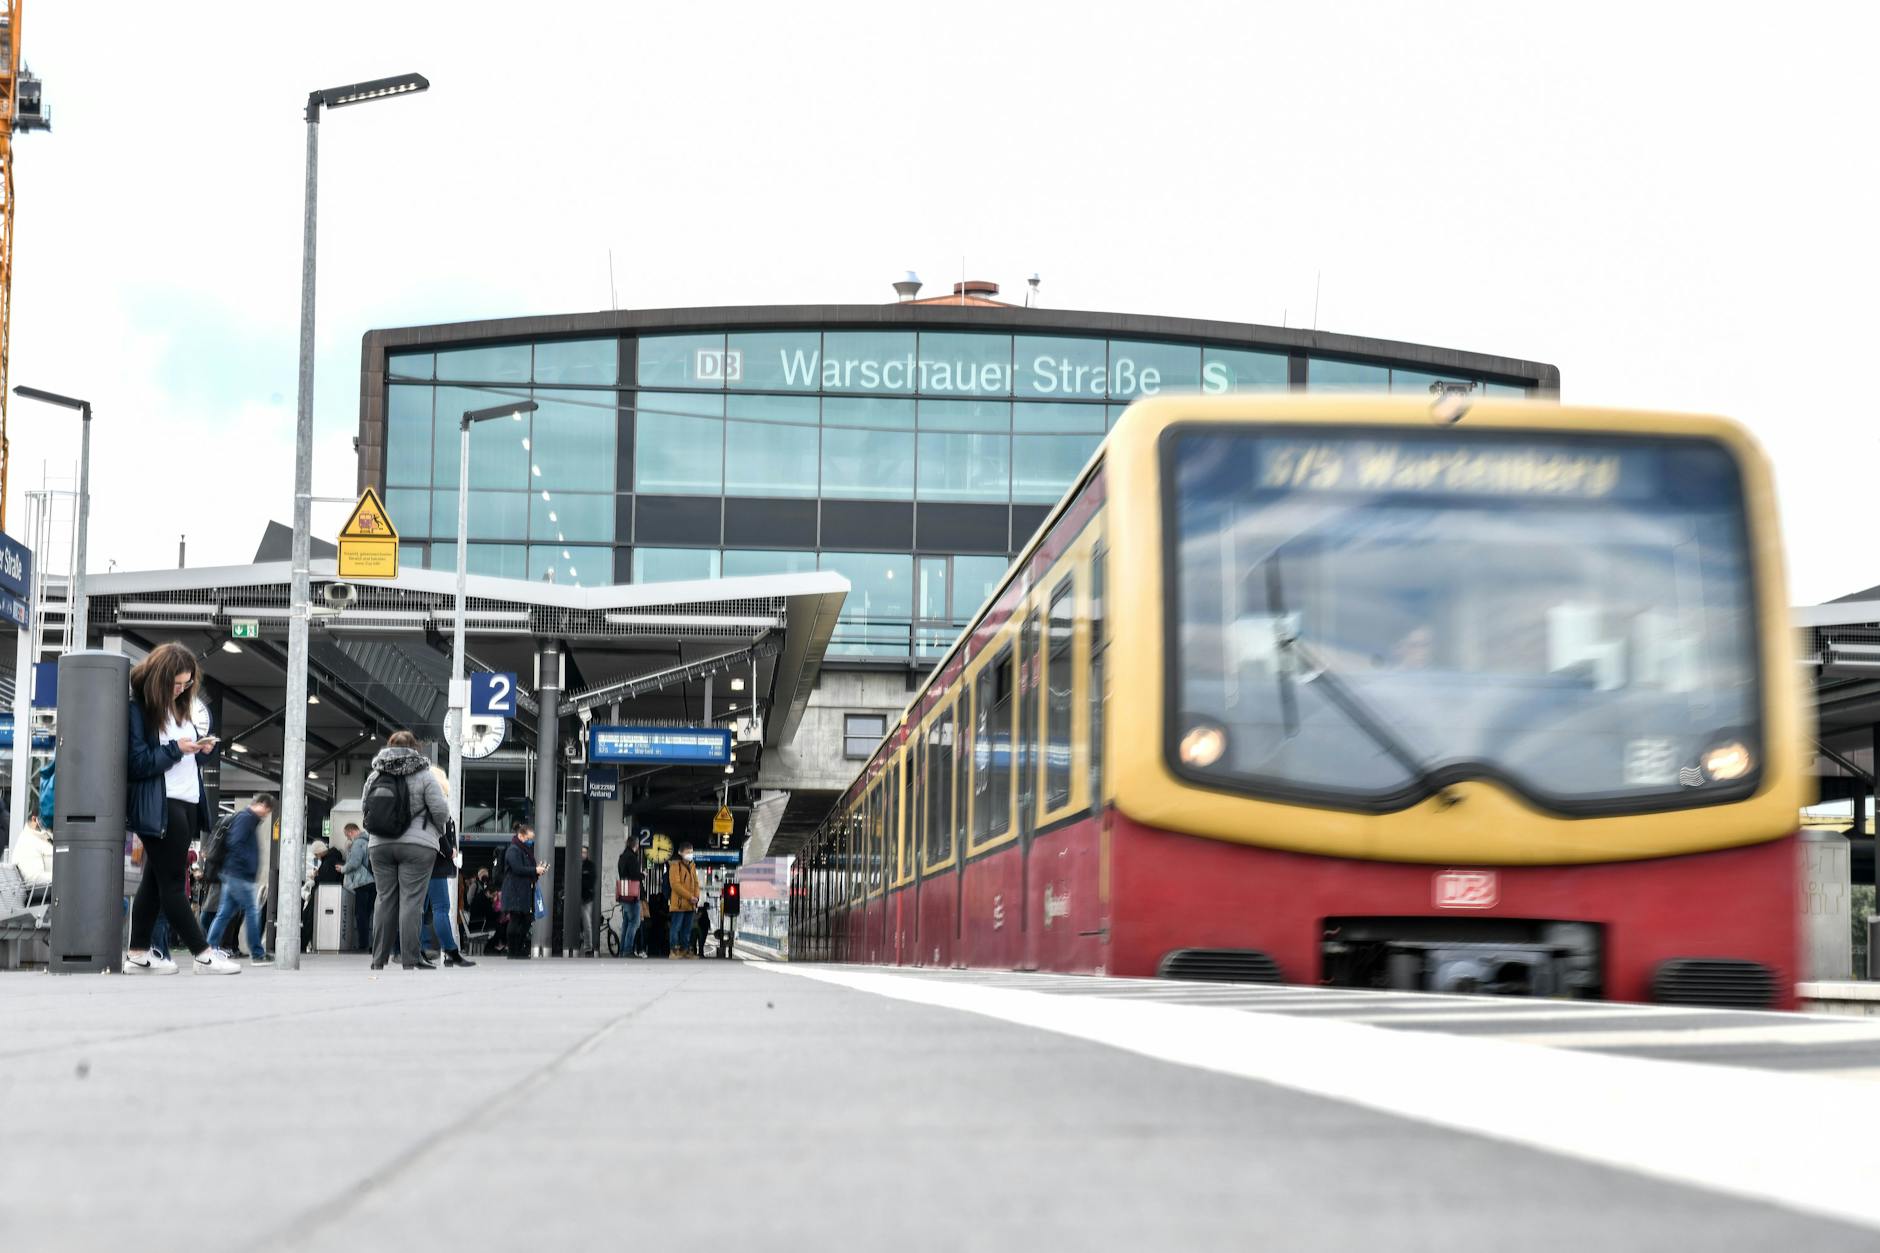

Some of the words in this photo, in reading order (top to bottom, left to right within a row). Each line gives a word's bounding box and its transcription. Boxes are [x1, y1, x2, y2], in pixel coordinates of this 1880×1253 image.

[698, 351, 740, 379] DB
[780, 349, 1019, 391] Warschauer
[1032, 356, 1161, 394] Straße
[1202, 361, 1229, 394] S
[4, 546, 23, 581] Straße
[488, 674, 510, 710] 2
[640, 829, 651, 846] 2
[1436, 873, 1496, 905] DB
